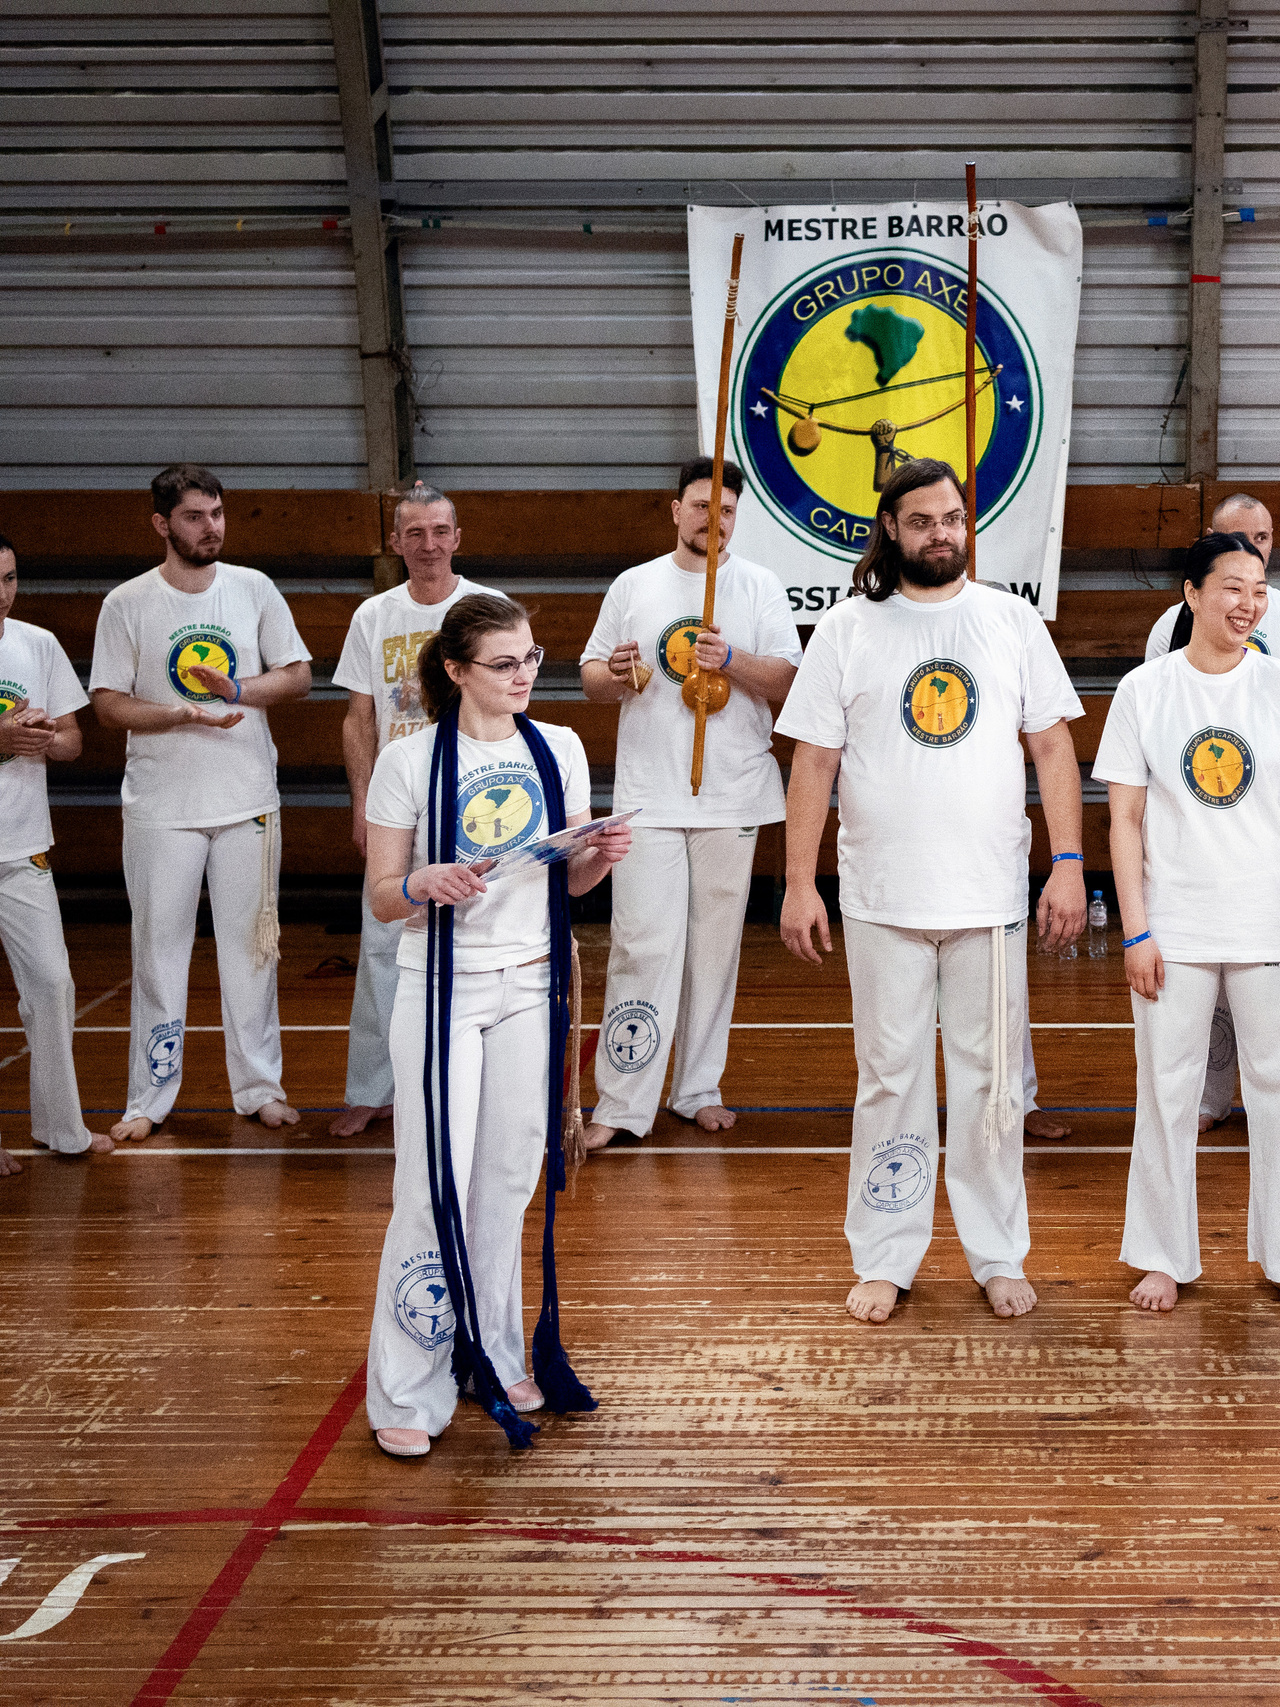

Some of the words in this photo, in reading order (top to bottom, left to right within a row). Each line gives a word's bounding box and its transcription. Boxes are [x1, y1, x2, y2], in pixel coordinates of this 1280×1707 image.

[764, 217, 878, 242] MESTRE
[792, 264, 905, 323] GRUPO
[168, 624, 198, 642] MESTRE
[179, 634, 205, 650] GRUPO
[382, 630, 439, 660] GRUP
[907, 669, 924, 693] GRUPO
[940, 664, 971, 688] CAPOEIRA
[912, 726, 938, 744] MESTRE
[942, 722, 969, 743] BARRÃO
[1186, 736, 1203, 757] GRUPO
[1217, 732, 1248, 756] CAPOEIRA
[468, 776, 504, 796] GRUPO
[1194, 787, 1220, 804] MESTRE
[608, 1000, 634, 1018] MESTRE
[636, 1000, 659, 1016] BARRÃO
[400, 1250, 441, 1270] MESTRE
[414, 1331, 448, 1346] CAPORA
